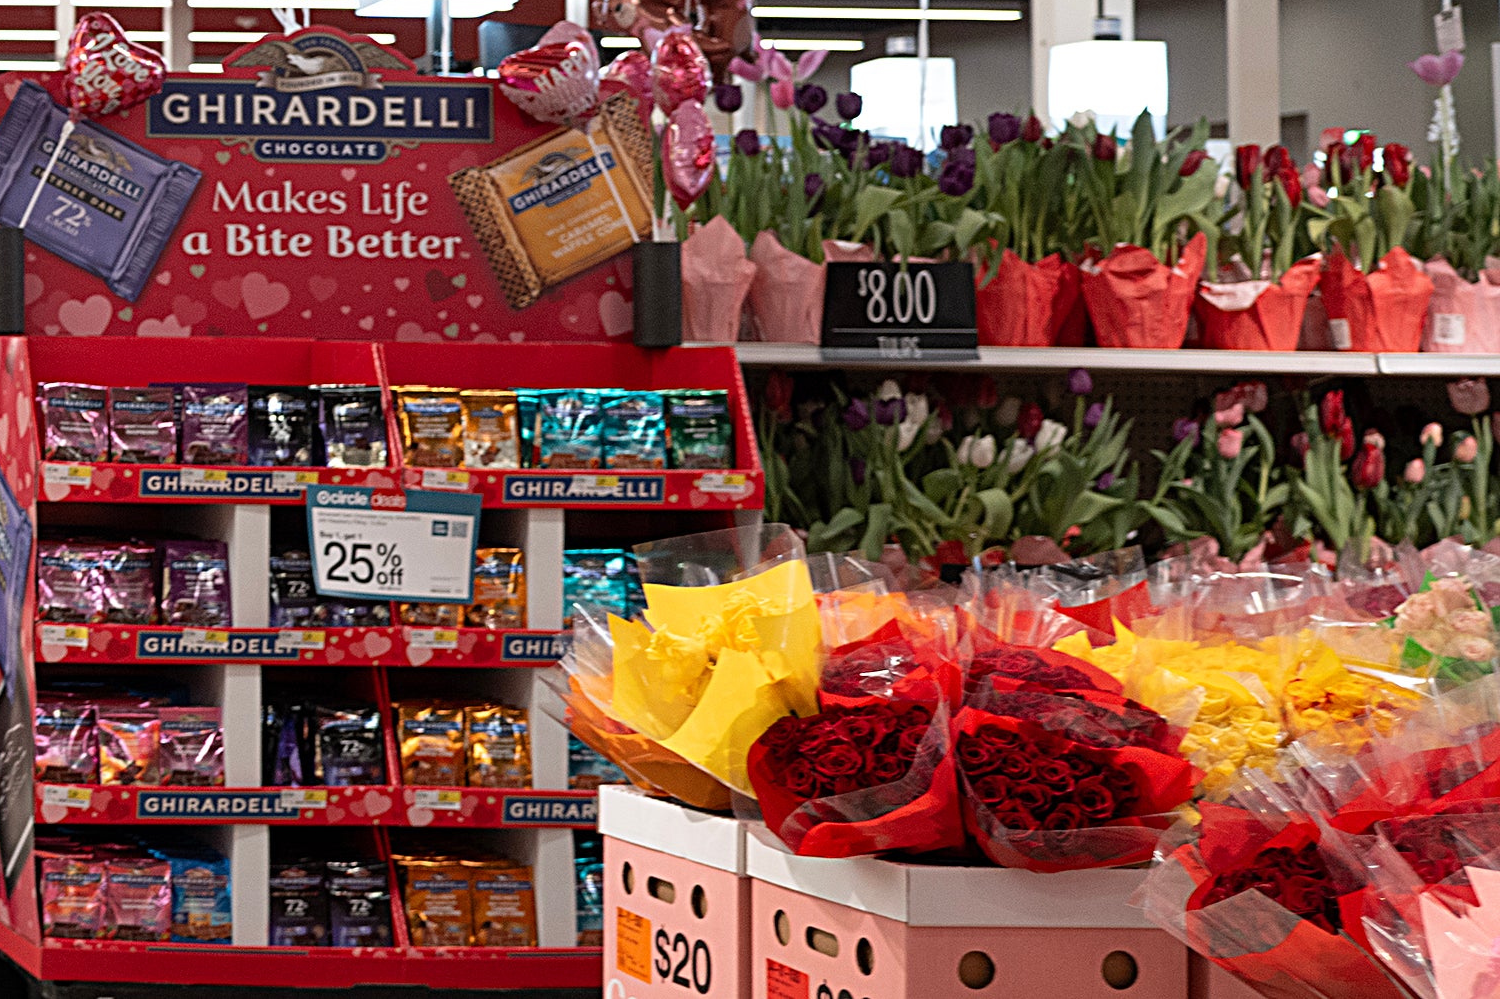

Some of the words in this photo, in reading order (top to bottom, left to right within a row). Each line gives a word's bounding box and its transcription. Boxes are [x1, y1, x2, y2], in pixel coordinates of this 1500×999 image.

[102, 43, 149, 82] Love
[163, 93, 476, 128] GHIRARDELLI
[261, 141, 378, 157] CHOCOLATE
[212, 180, 347, 214] Makes
[361, 181, 428, 224] Life
[182, 232, 211, 255] a
[225, 223, 312, 257] Bite
[858, 269, 936, 324] $8.00
[377, 568, 404, 586] off
[654, 924, 712, 995] $20
